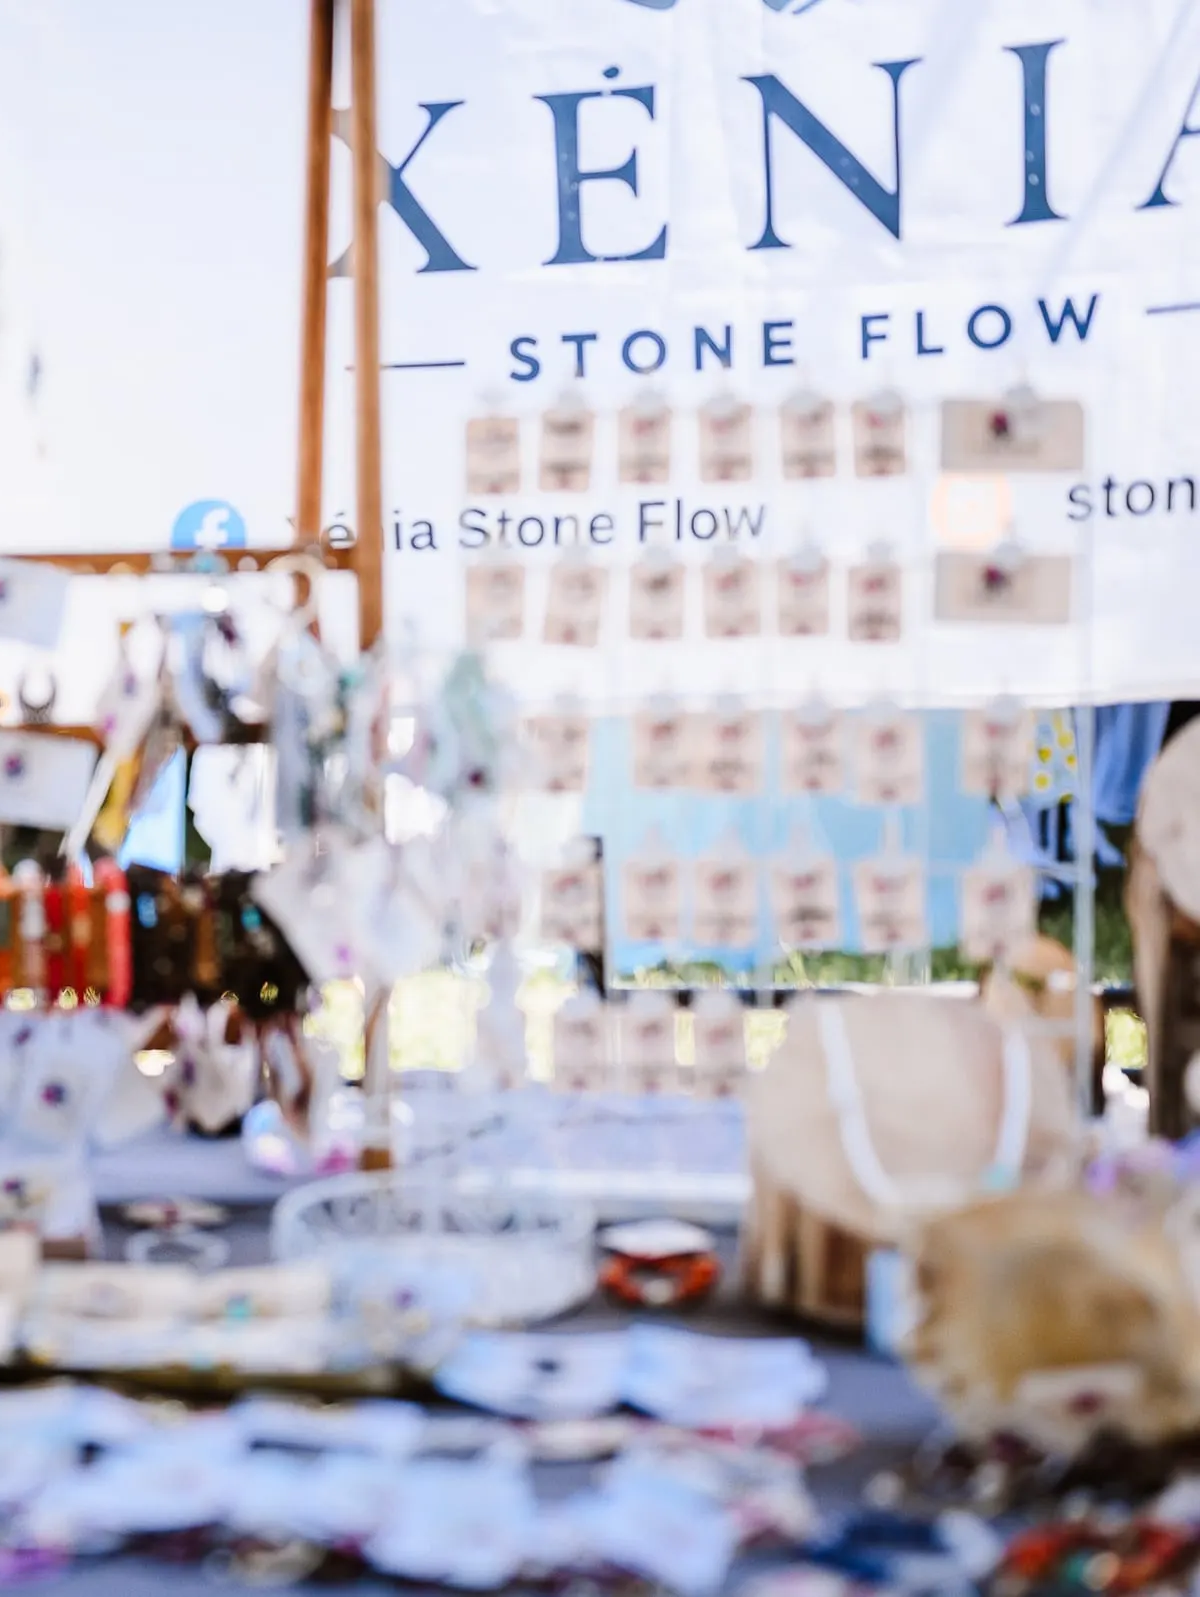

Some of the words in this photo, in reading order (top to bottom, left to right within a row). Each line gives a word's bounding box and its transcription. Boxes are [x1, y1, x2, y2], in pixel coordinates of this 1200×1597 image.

[508, 320, 795, 382] STONE
[861, 293, 1100, 360] FLOW
[284, 509, 438, 551] éia
[457, 507, 616, 548] Stone
[637, 498, 765, 541] Flow
